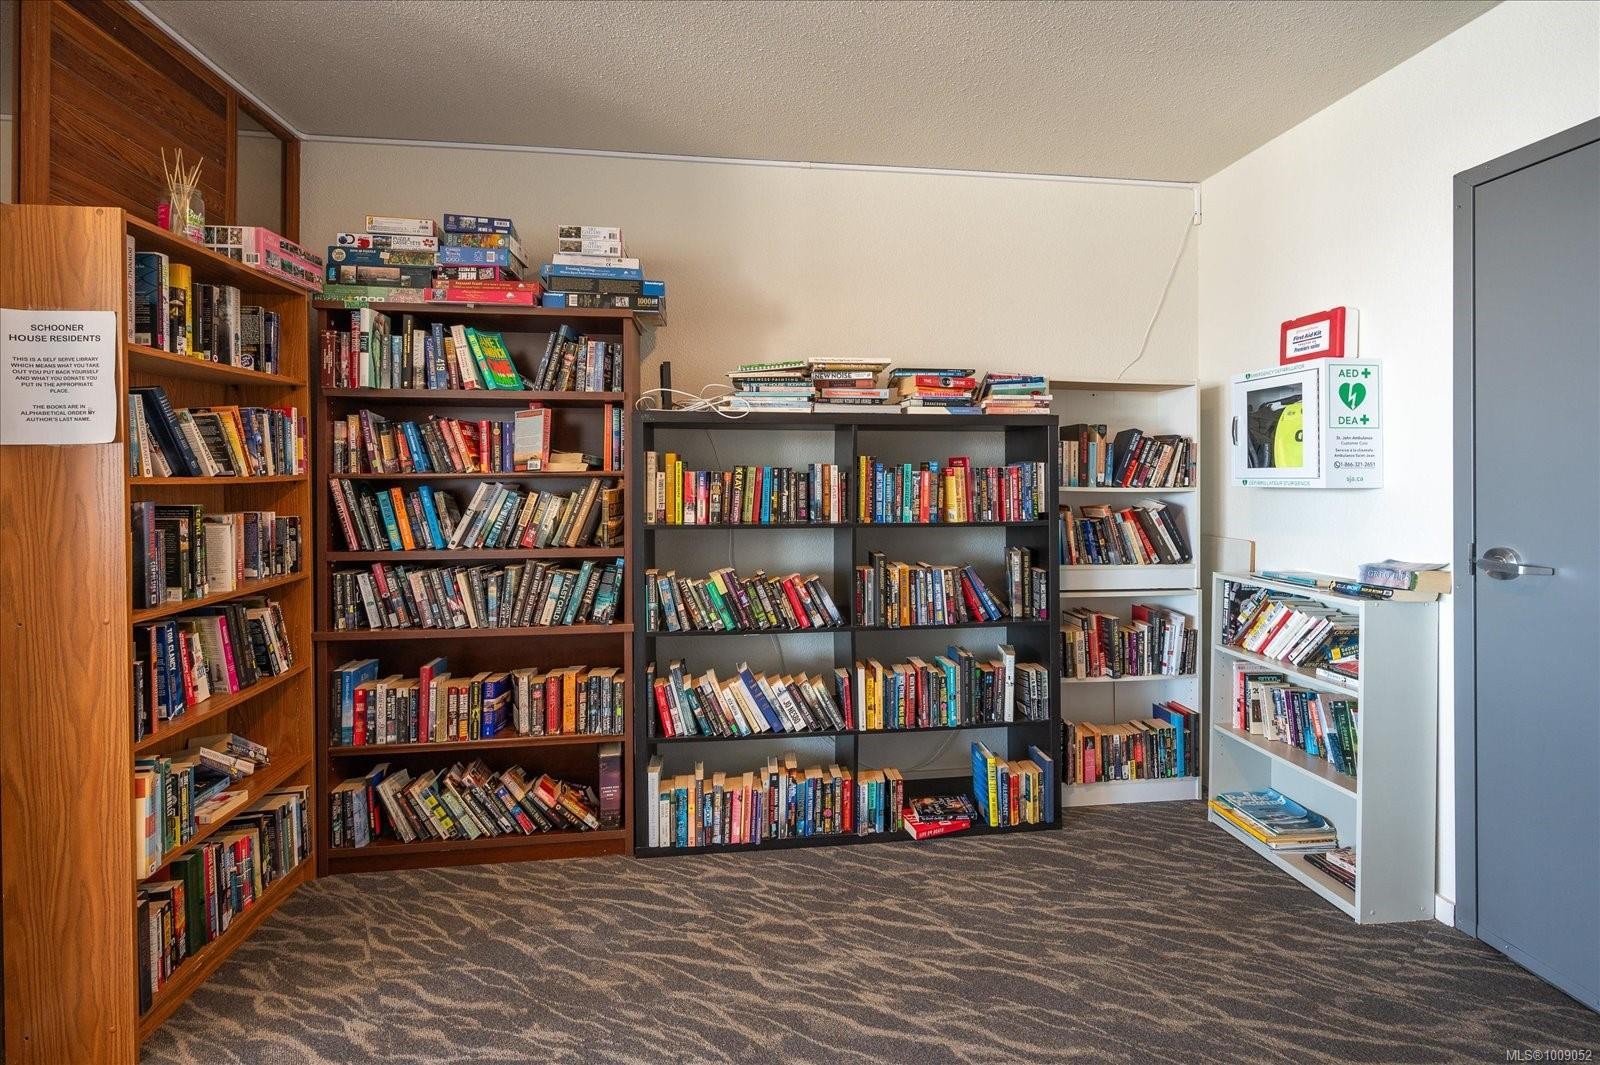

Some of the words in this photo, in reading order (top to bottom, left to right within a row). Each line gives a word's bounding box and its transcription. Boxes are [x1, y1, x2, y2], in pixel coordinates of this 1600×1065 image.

[9, 334, 47, 342] HOUSE
[1293, 334, 1304, 343] First
[1304, 332, 1314, 340] Aid
[1314, 330, 1322, 338] Kit
[435, 357, 445, 371] 419
[1338, 369, 1359, 378] AED
[1338, 416, 1358, 425] DEA
[734, 468, 742, 490] KRAY
[557, 581, 569, 601] LAST
[552, 599, 564, 621] CHILD
[165, 627, 173, 642] TOM
[166, 644, 176, 670] CLANCY
[783, 699, 792, 708] JO
